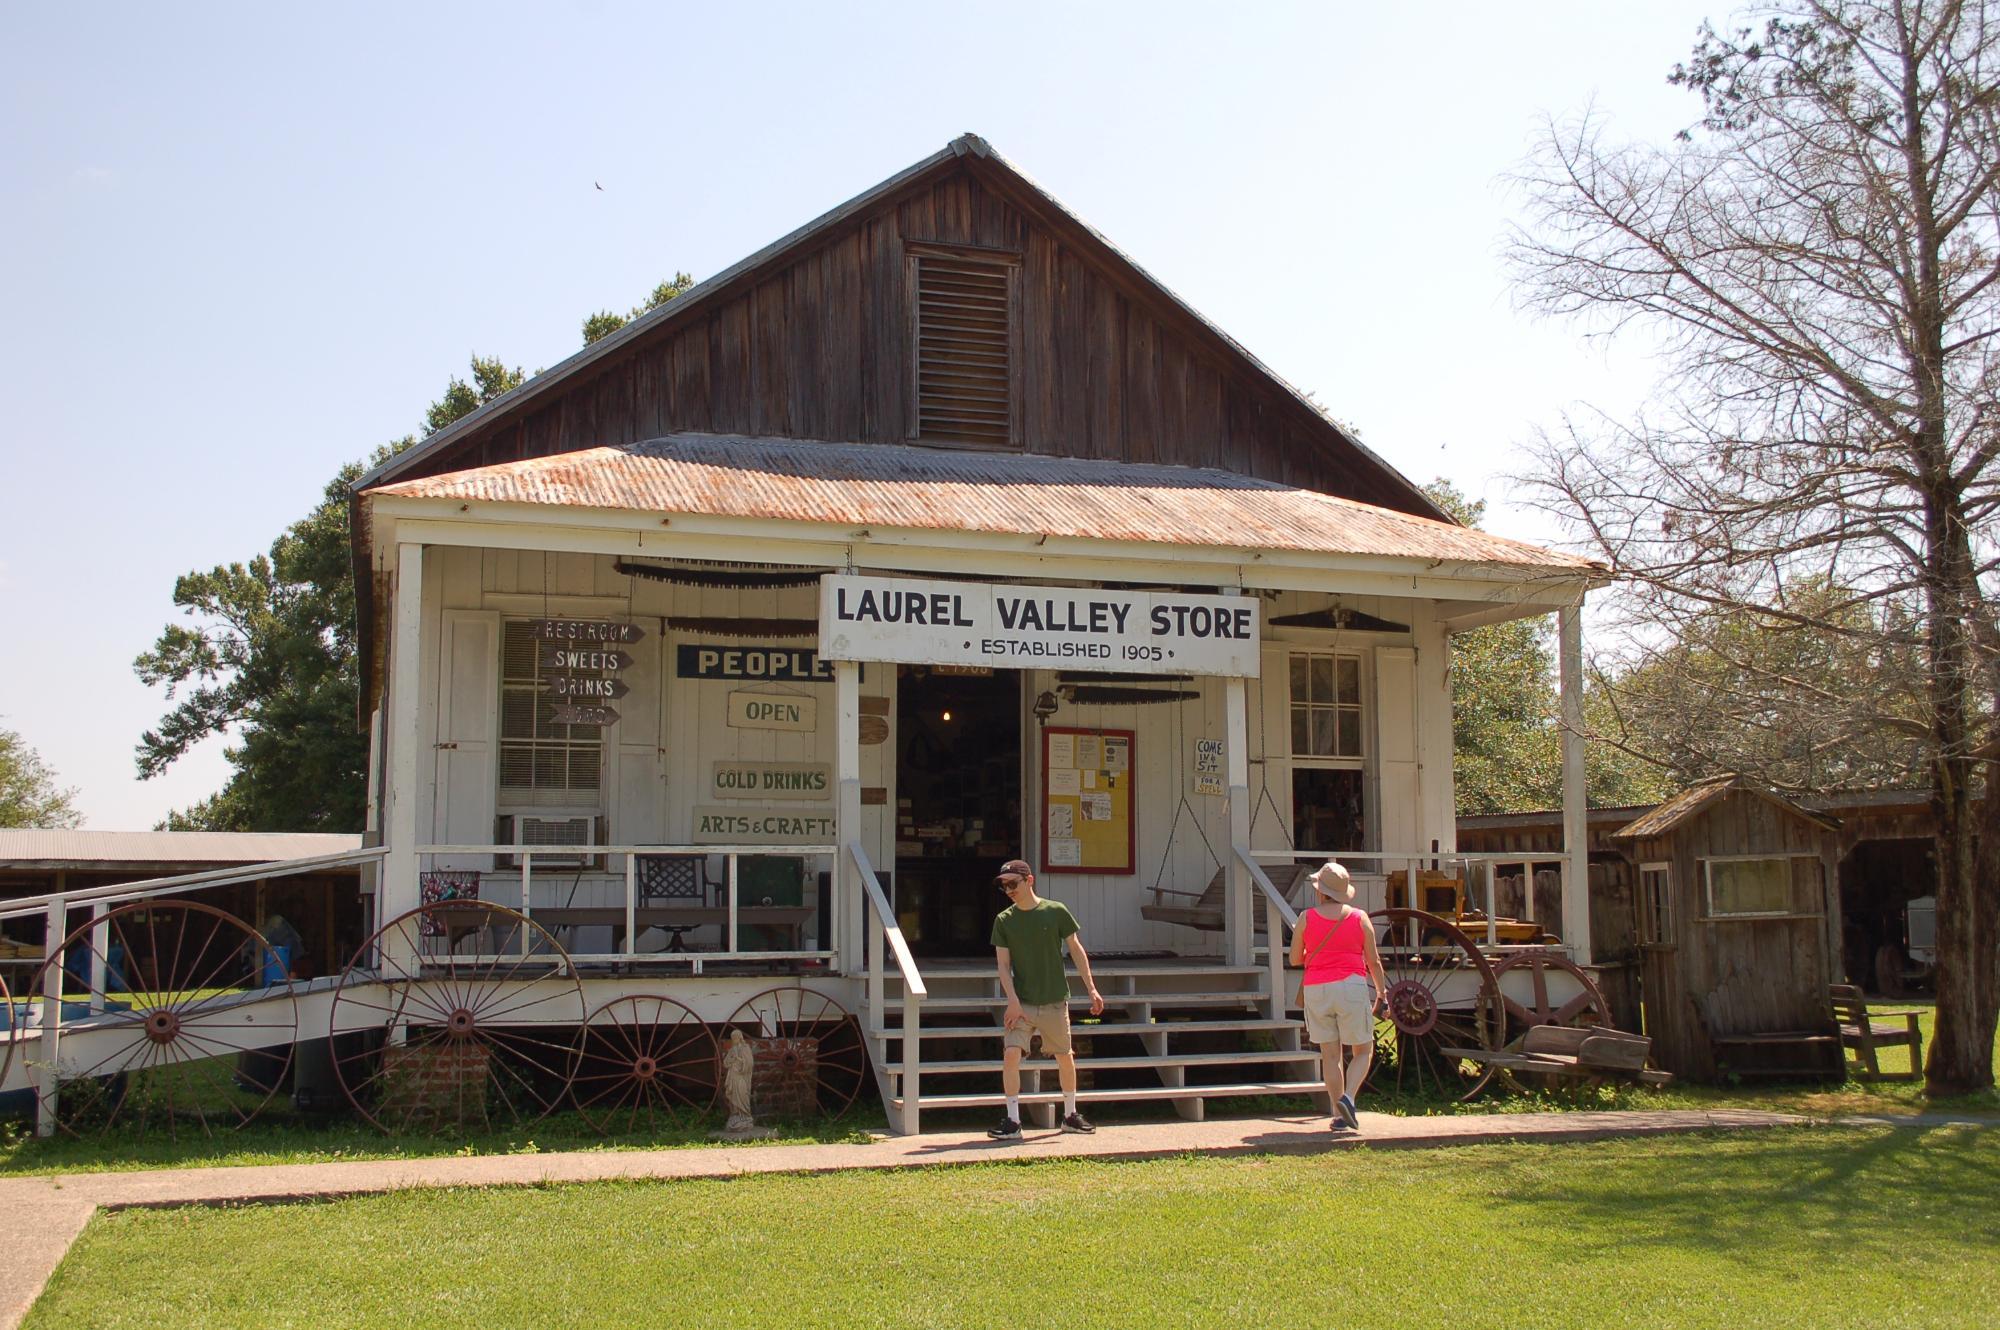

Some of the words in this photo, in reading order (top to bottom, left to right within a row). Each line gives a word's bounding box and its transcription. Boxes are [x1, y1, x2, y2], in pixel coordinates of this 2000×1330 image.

[838, 588, 974, 627] LAUREL
[996, 597, 1131, 634] VALLEY
[1150, 605, 1252, 639] STORE
[546, 621, 629, 640] RESTROOM
[555, 650, 618, 670] SWEETS
[981, 639, 1111, 659] ESTABLISHED
[1122, 645, 1163, 661] 1905
[699, 650, 836, 678] PEOPLE
[559, 678, 614, 696] DRINKS
[745, 702, 801, 722] OPEN
[1197, 740, 1224, 755] COME
[1197, 760, 1218, 772] SIT
[716, 769, 757, 788] COLD
[763, 771, 826, 790] DRINKS
[700, 815, 749, 833] ARTS
